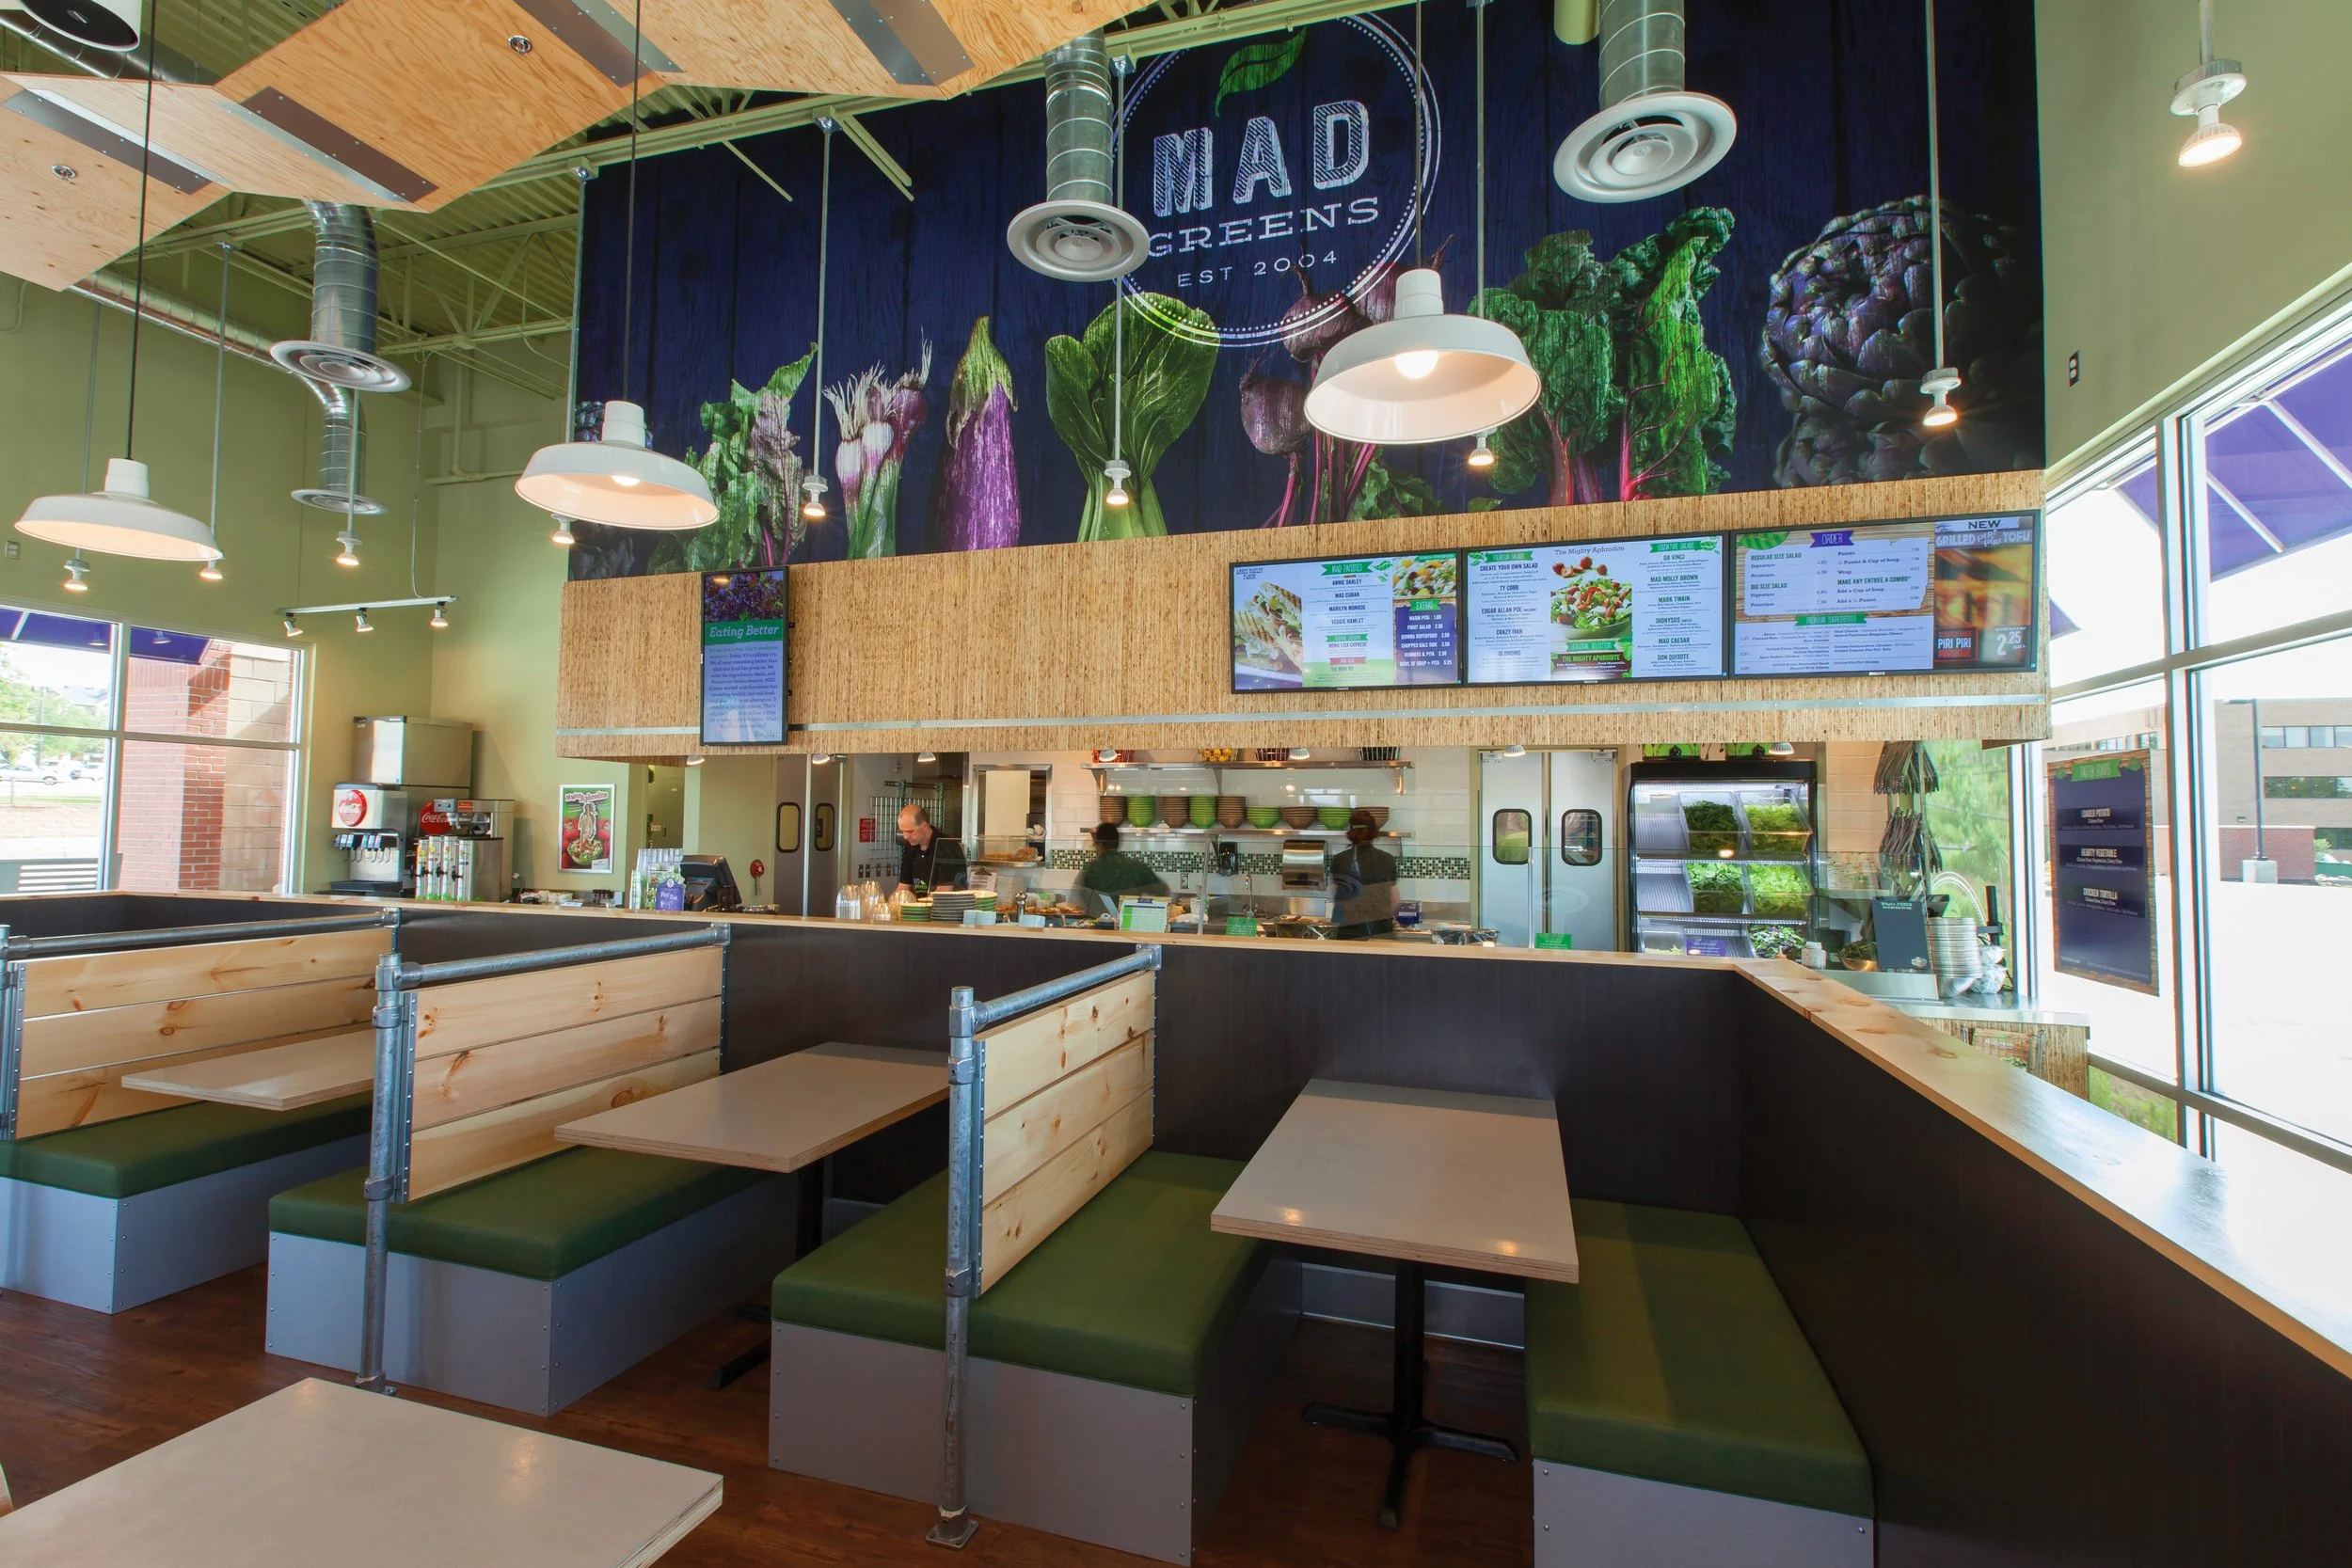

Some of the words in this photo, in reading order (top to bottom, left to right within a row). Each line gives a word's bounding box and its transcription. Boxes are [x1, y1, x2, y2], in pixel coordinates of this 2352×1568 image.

[1152, 100, 1370, 218] MAD
[1147, 197, 1379, 258] GREENS
[1178, 267, 1233, 288] EST
[1253, 250, 1337, 277] 2004
[1968, 520, 2000, 530] NEW
[1822, 533, 1842, 545] ORDER
[1935, 533, 1976, 546] GRILLED
[2003, 531, 2030, 543] TOFU
[1417, 601, 1433, 610] EXTRAS
[709, 626, 743, 639] Eating
[746, 626, 779, 636] Better
[1938, 638, 1953, 649] PIRI
[1956, 638, 1972, 648] PIRI
[2081, 809, 2095, 817] LOADED
[2096, 808, 2110, 816] POTATO
[2080, 848, 2095, 857] HEARTY
[2095, 849, 2117, 858] VEGETABLE
[2083, 888, 2100, 896] CHICKEN
[2100, 889, 2118, 899] TORTILLA
